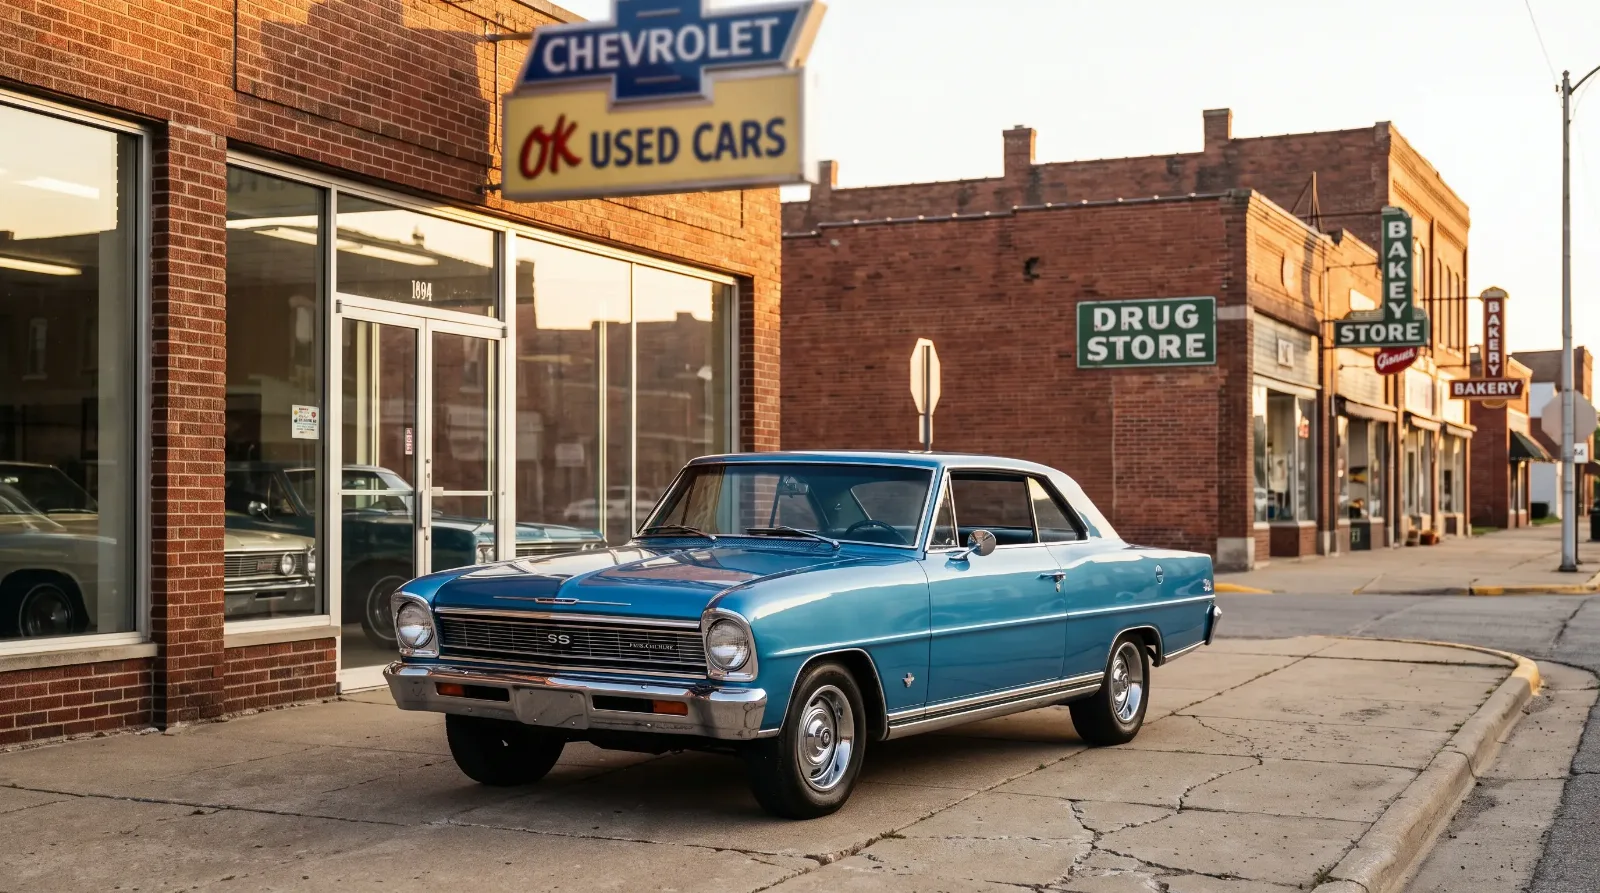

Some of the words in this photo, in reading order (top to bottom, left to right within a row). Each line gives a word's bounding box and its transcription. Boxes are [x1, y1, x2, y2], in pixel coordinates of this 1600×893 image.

[543, 18, 779, 73] CHEVROLET
[519, 114, 582, 180] OK
[590, 127, 680, 169] USED
[693, 118, 787, 163] CARS
[1387, 221, 1408, 320] BAKEY
[1094, 303, 1199, 332] DRUG
[1087, 333, 1206, 361] STORE
[1340, 322, 1421, 343] STORE
[1488, 301, 1501, 376] BAKERY
[1454, 381, 1518, 396] BAKERY
[548, 634, 570, 644] SS
